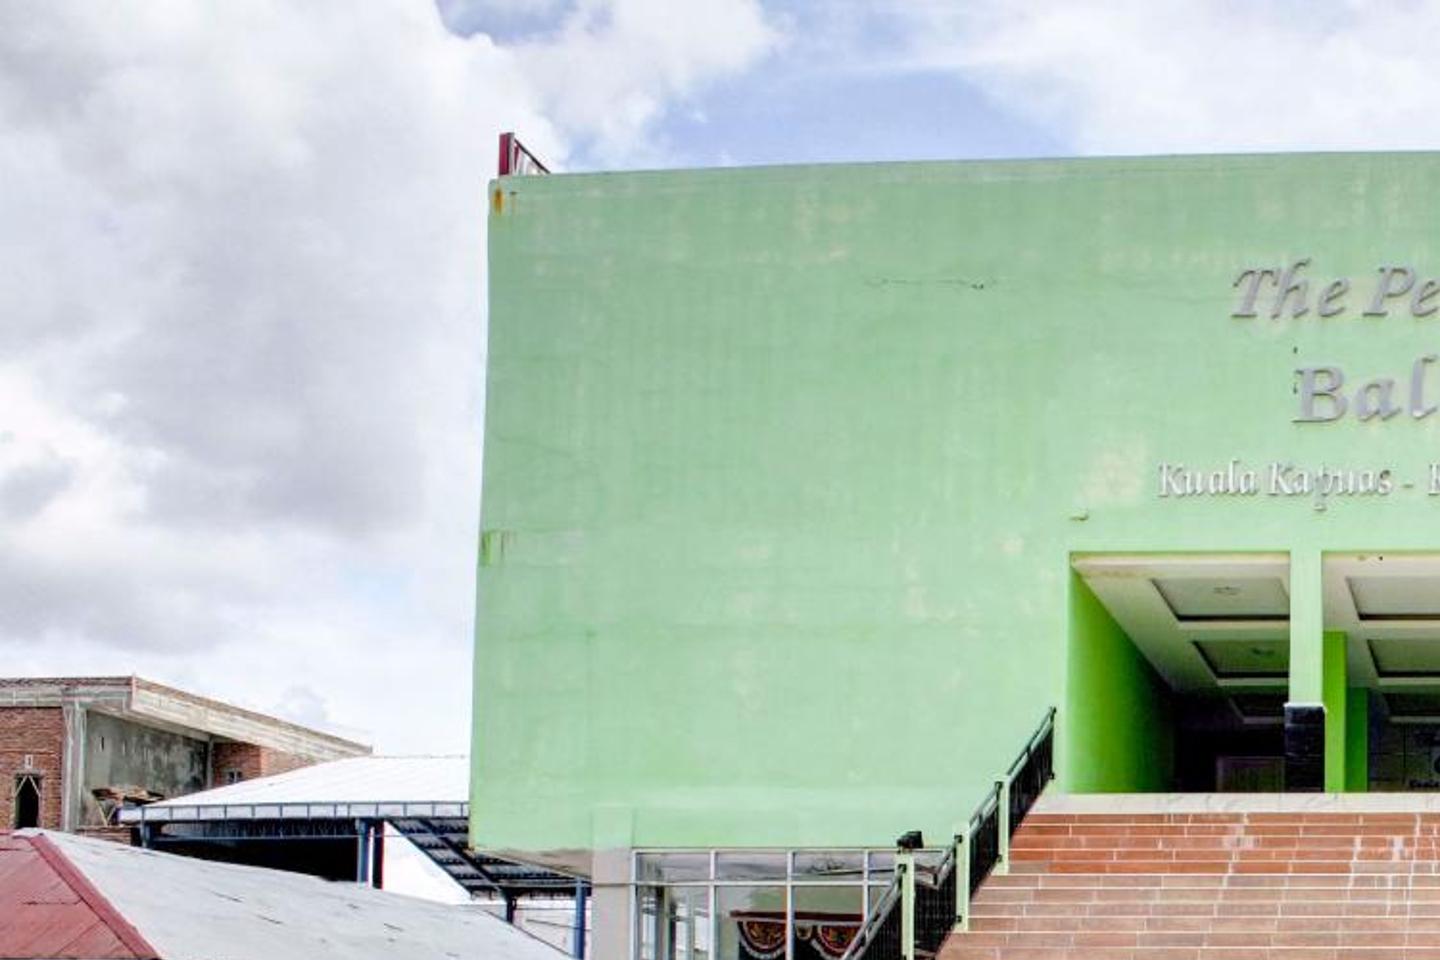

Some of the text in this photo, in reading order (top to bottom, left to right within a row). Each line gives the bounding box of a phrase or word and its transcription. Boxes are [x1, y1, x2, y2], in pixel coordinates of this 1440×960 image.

[1231, 259, 1349, 320] The
[1158, 460, 1257, 497] Kuala
[1267, 462, 1393, 513] Kapuas
